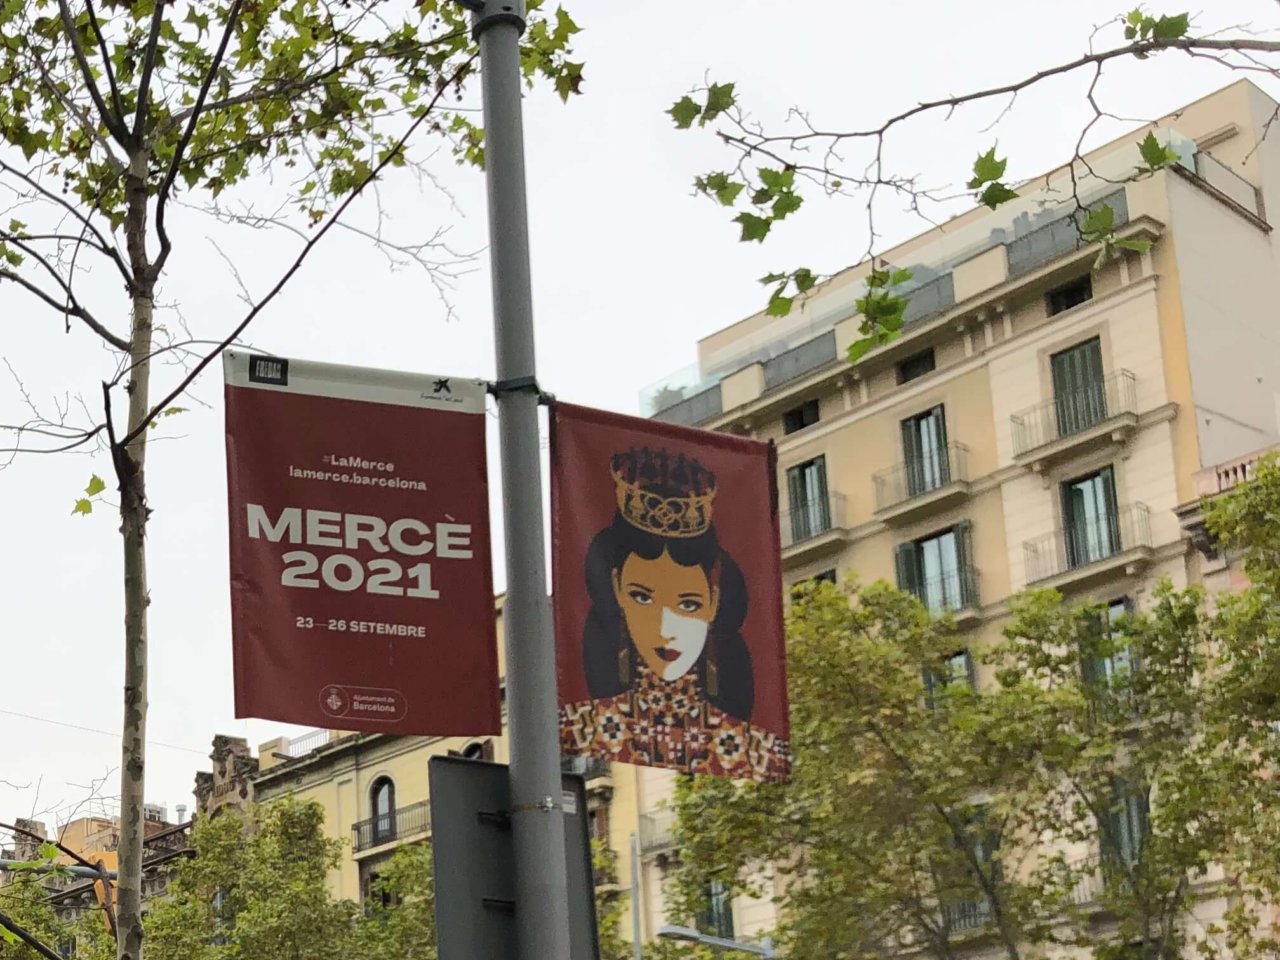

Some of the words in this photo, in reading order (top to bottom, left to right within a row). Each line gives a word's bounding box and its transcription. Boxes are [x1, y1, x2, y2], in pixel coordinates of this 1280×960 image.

[289, 465, 427, 491] lamerce.barcelona
[247, 503, 473, 558] MERCÈ
[281, 551, 440, 599] 2021
[350, 620, 426, 638] SETEMBRE
[353, 702, 395, 713] Barcelona
